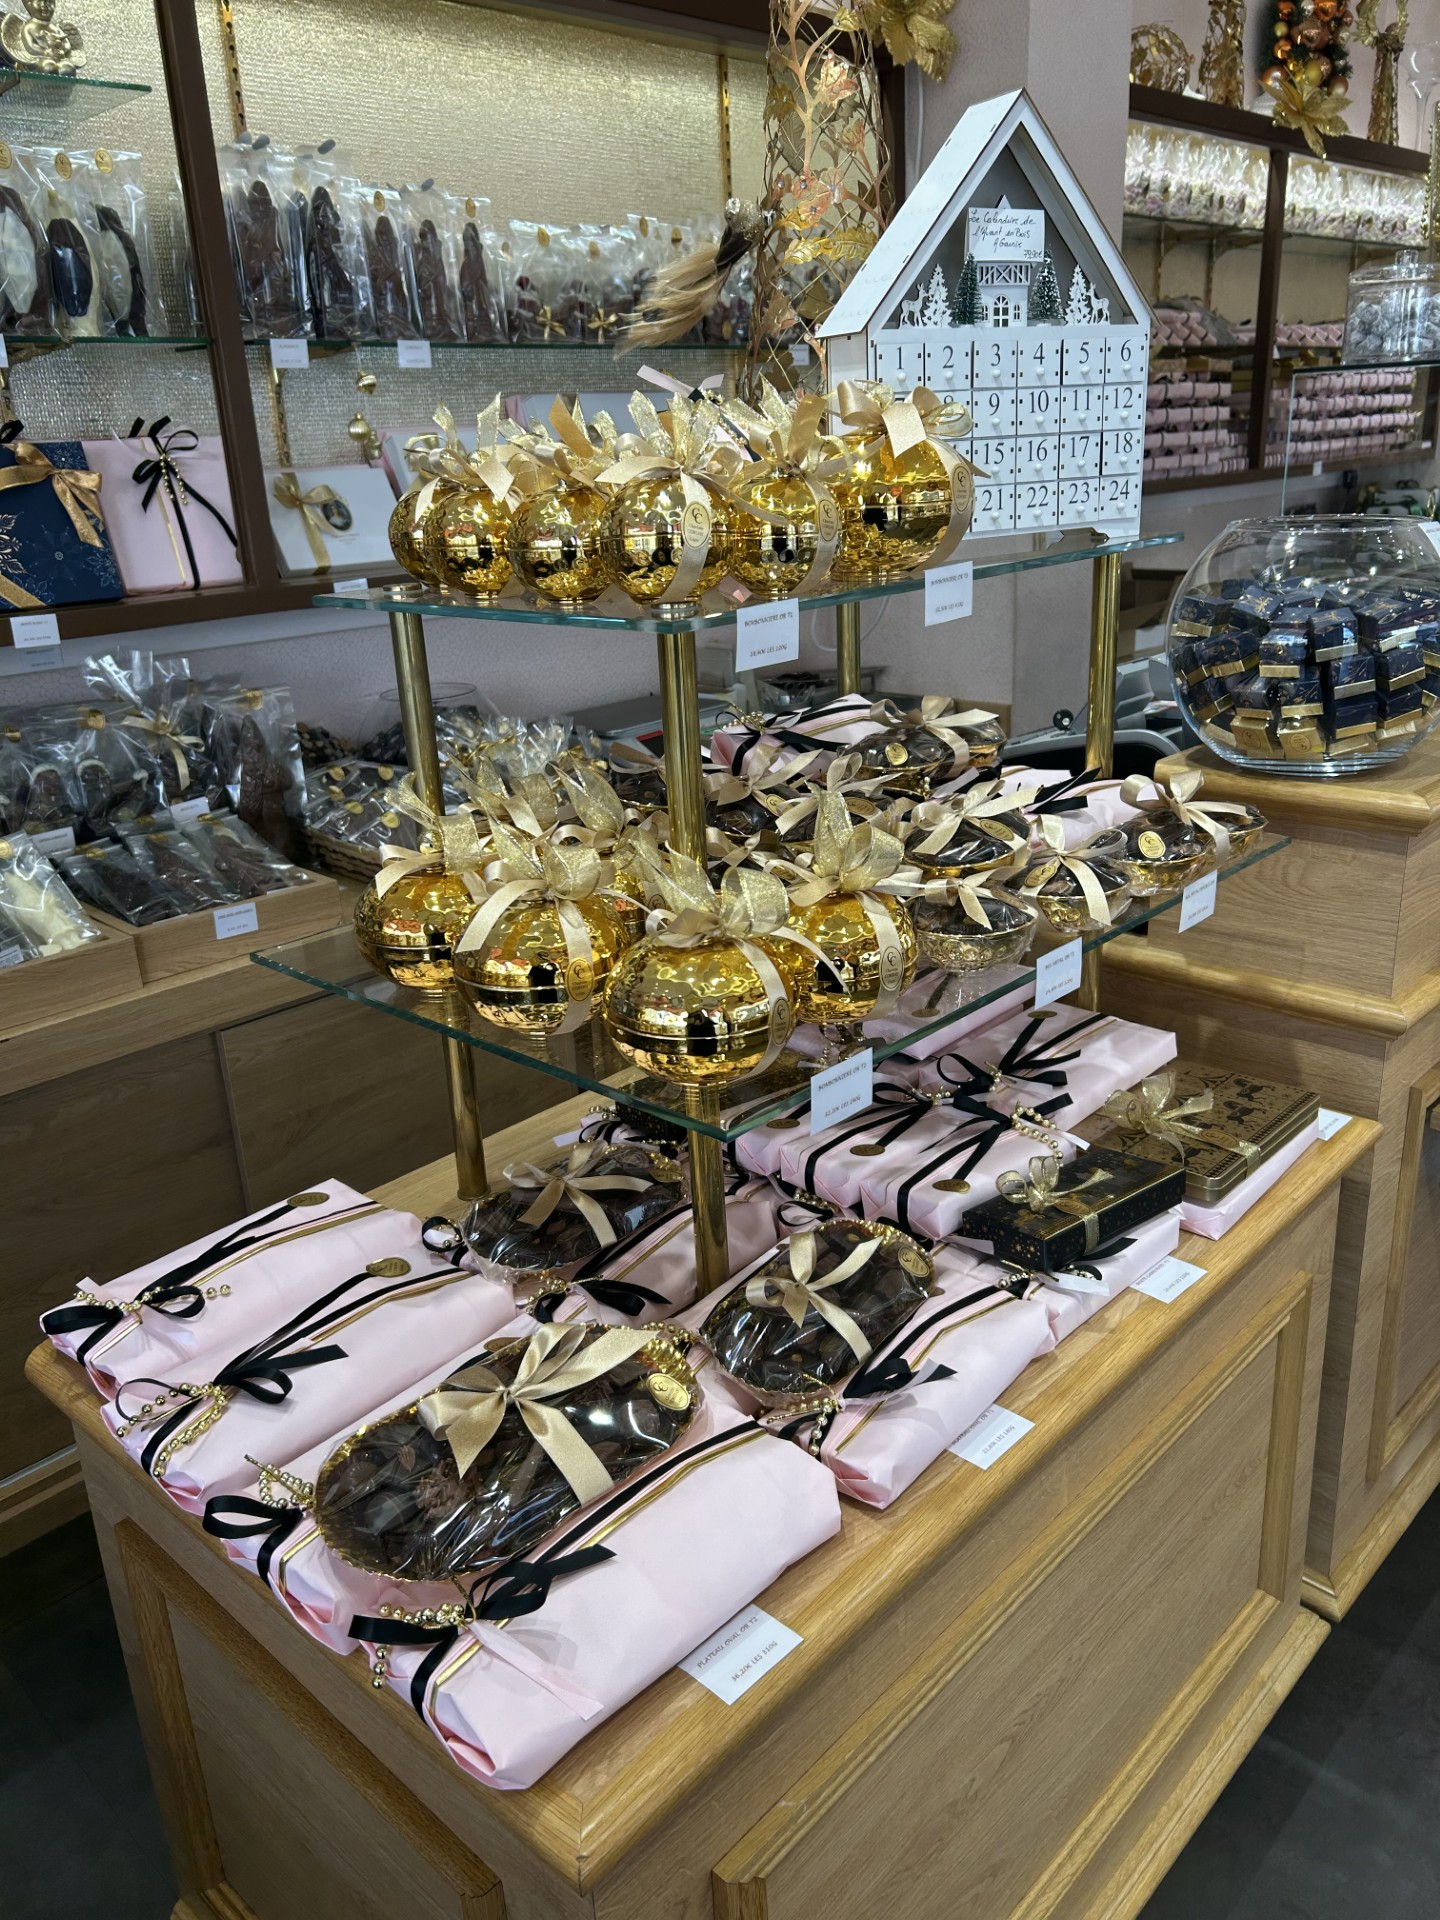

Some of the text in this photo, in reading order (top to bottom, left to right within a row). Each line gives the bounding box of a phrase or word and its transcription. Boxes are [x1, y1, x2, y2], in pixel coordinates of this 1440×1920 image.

[1020, 214, 1037, 225] de
[1015, 227, 1031, 238] Bois
[897, 346, 905, 370] 1
[943, 345, 954, 369] 2
[990, 344, 1001, 367] 3
[1033, 342, 1045, 365] 4
[1079, 342, 1090, 364] 5
[1121, 339, 1131, 361] 6
[989, 392, 1000, 416] 9
[1029, 390, 1049, 413] 10
[1073, 388, 1091, 411] 11
[1113, 387, 1133, 409] 12
[984, 442, 1005, 465] 15
[1027, 439, 1048, 462] 16
[1070, 436, 1090, 458] 17
[1114, 432, 1133, 454] 18
[982, 488, 1003, 511] 21
[1027, 485, 1049, 508] 22
[1069, 482, 1090, 504] 23
[1109, 479, 1130, 501] 24
[691, 507, 703, 524] CC
[696, 1615, 759, 1668] PLATEAU OVAL OR T2
[749, 1652, 764, 1665] LES
